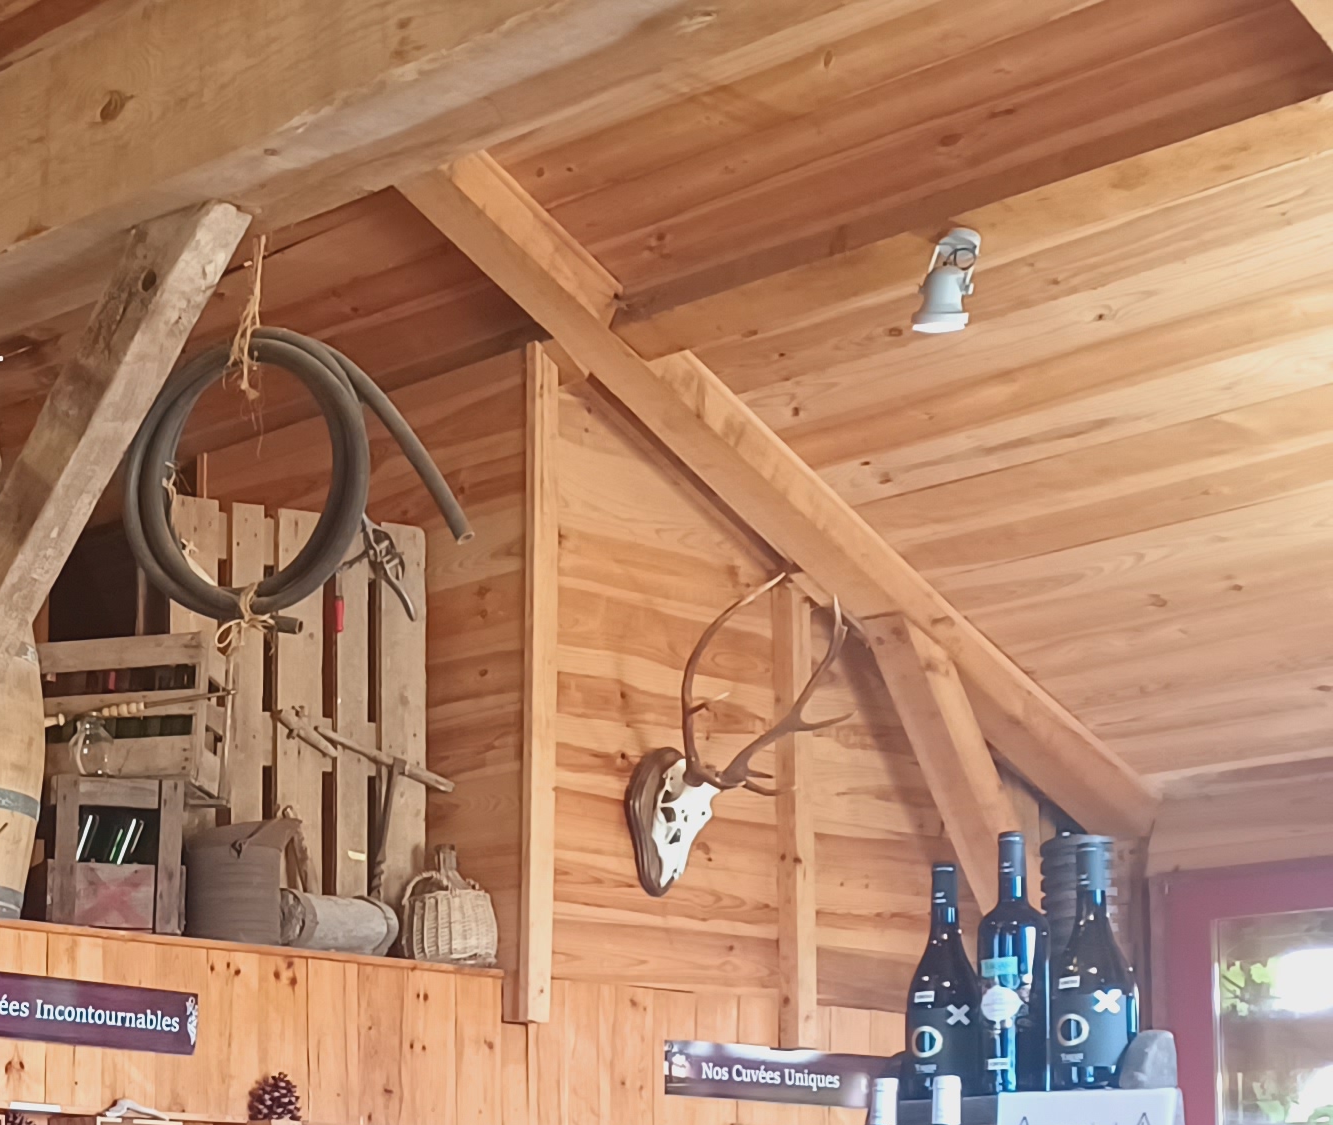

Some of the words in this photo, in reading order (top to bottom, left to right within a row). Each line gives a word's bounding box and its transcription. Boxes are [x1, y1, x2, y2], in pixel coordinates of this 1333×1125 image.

[35, 999, 180, 1033] Incontournables
[701, 1061, 729, 1080] Nos
[732, 1064, 781, 1084] Cuvées
[784, 1069, 841, 1092] Uniques
